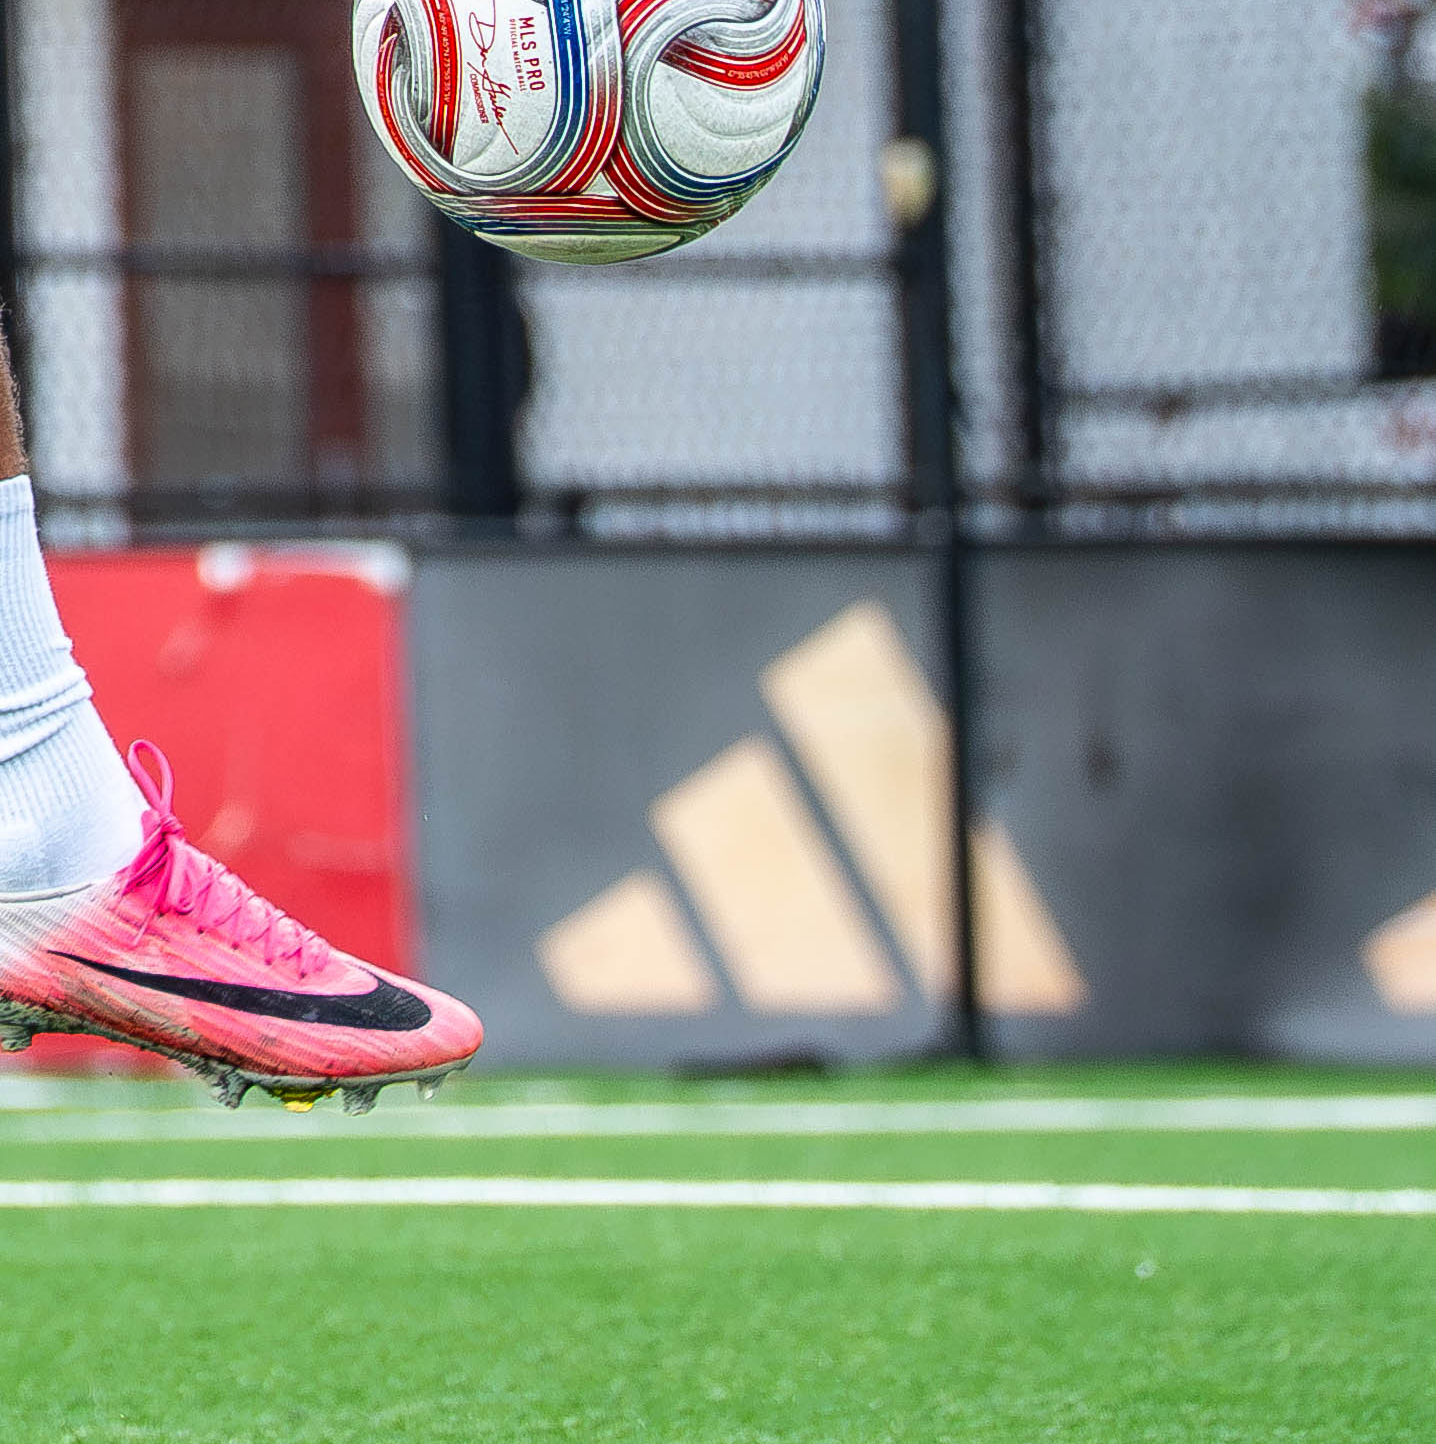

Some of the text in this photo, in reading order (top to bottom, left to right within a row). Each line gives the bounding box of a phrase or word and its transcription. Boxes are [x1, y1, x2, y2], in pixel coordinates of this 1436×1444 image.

[508, 18, 527, 92] OFFICIAL MATCH BALL
[518, 16, 546, 91] MLS PRO
[469, 73, 490, 124] COMMISSIONER
